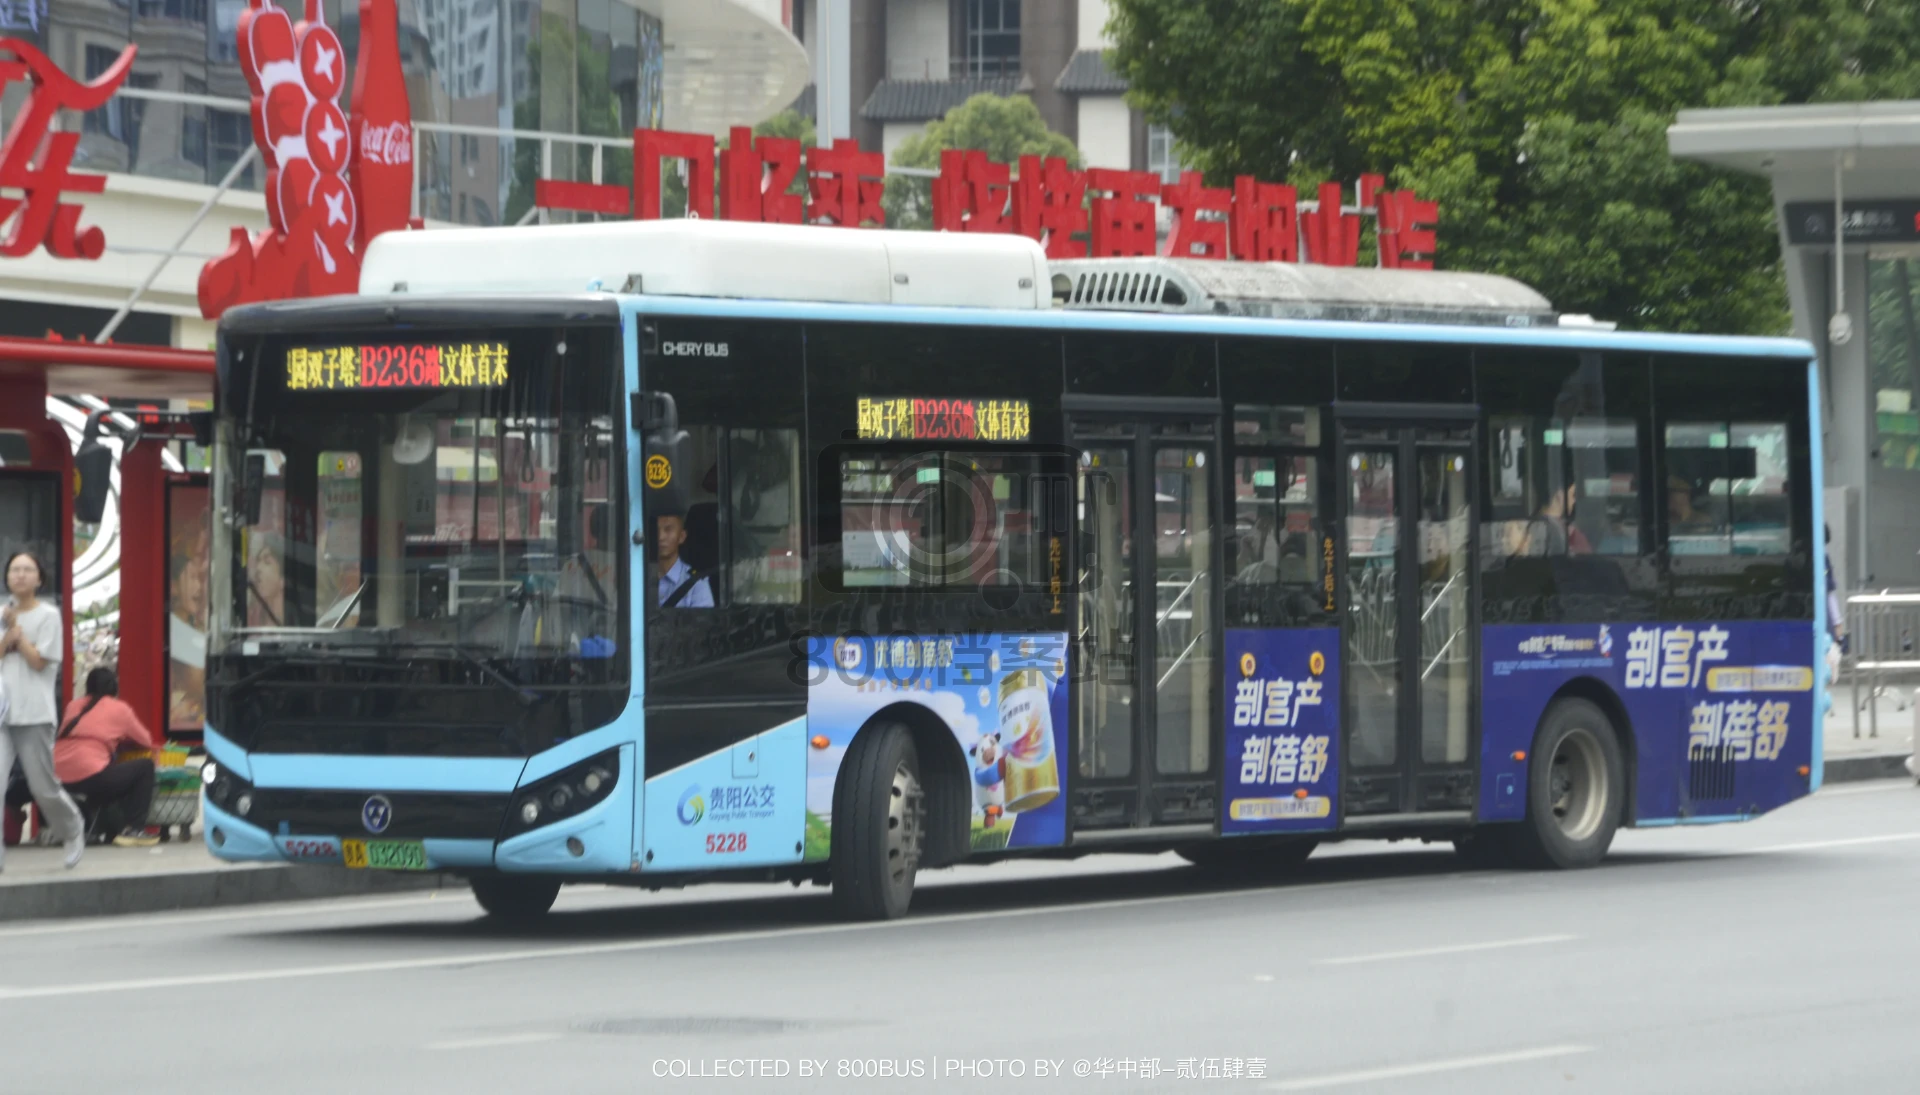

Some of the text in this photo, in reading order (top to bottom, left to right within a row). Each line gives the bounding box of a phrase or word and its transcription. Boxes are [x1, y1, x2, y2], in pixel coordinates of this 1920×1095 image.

[663, 341, 729, 357] CHERY BUS
[1624, 624, 1730, 689] 剖宫产
[1234, 677, 1324, 728] 剖宫产
[1240, 734, 1330, 785] 剖蓓舒
[710, 784, 776, 811] 贵阳公交
[285, 840, 337, 857] 5228
[706, 832, 748, 854] 5228
